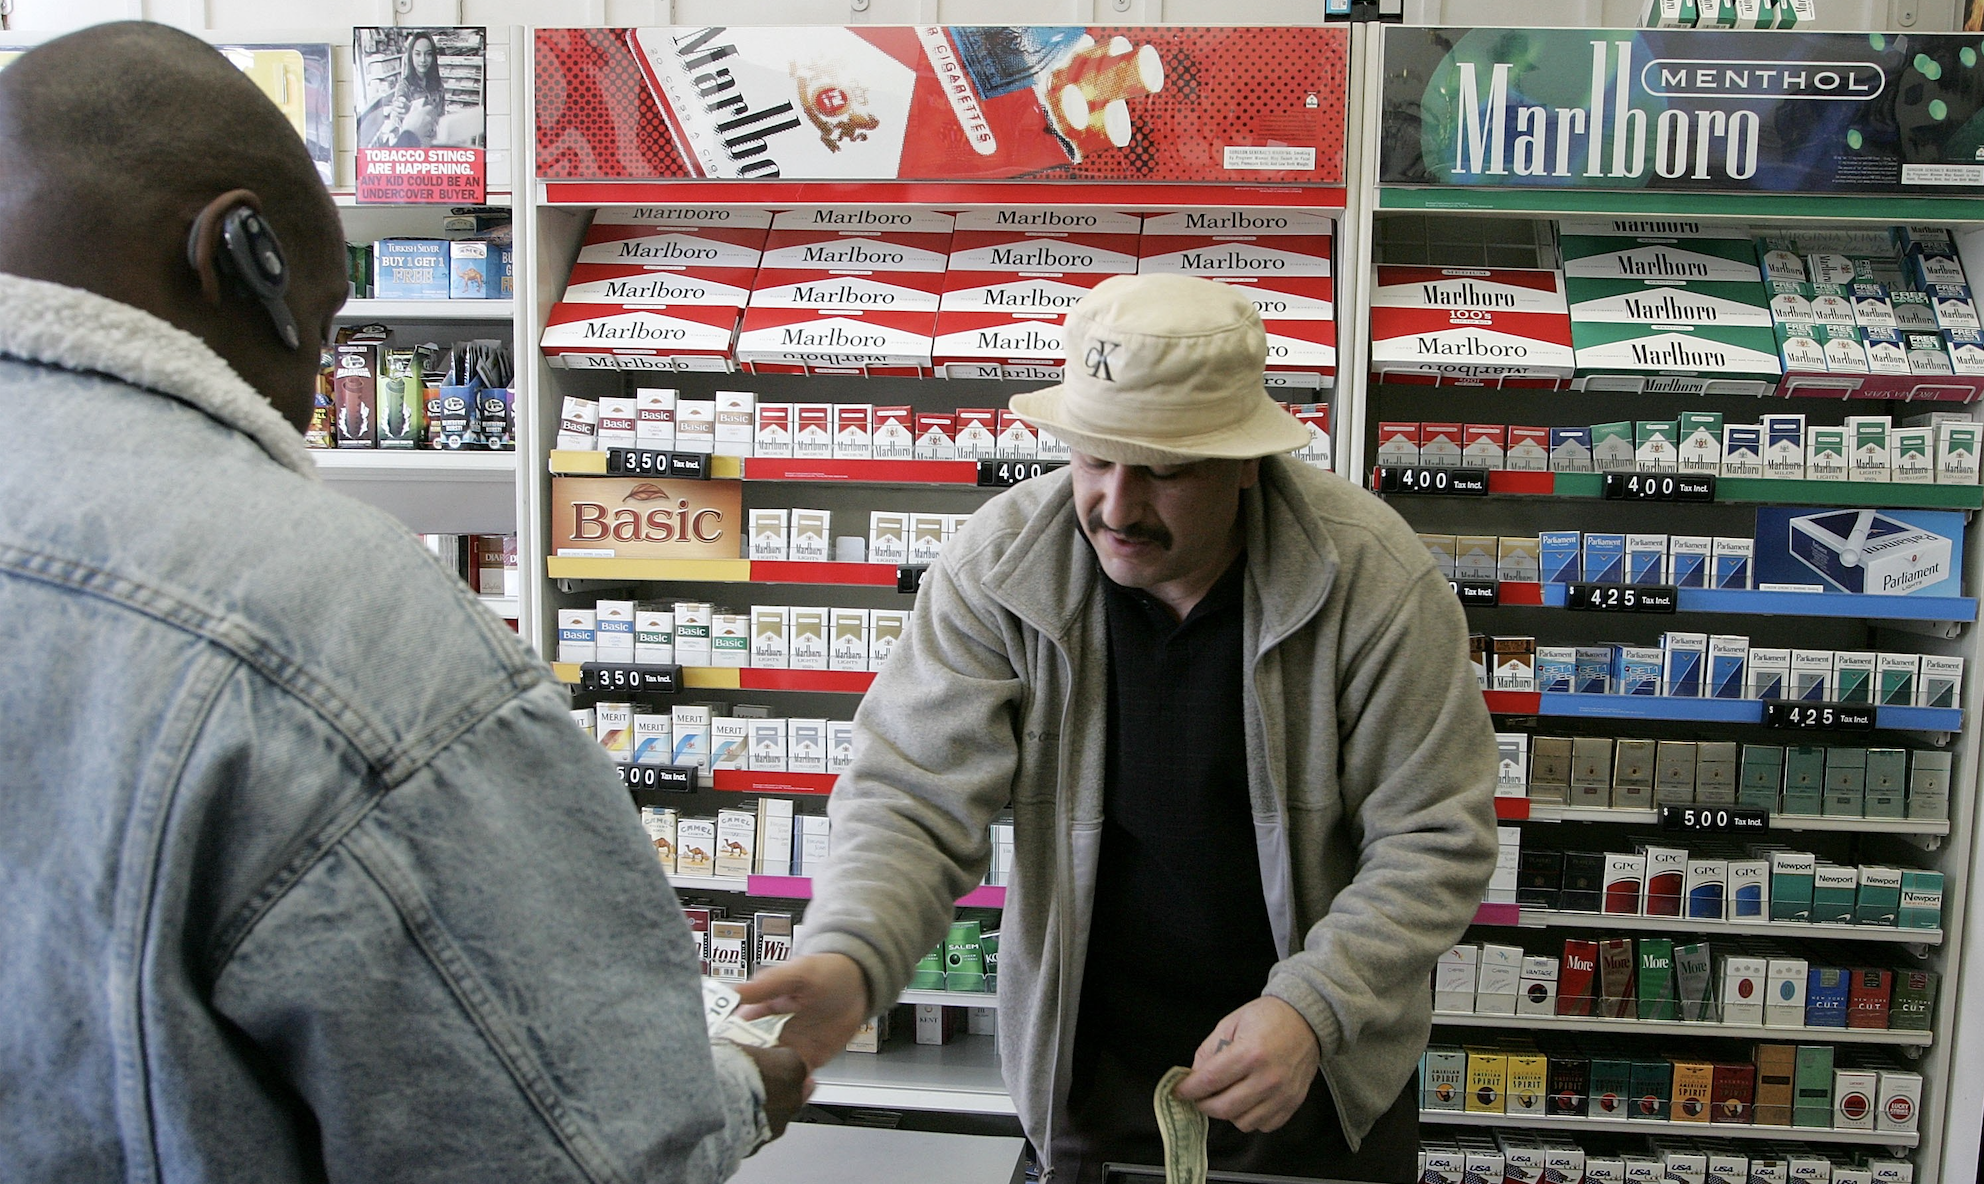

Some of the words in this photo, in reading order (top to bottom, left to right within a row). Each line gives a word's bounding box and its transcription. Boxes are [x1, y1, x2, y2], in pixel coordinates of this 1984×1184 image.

[1660, 69, 1869, 92] MENTHOL
[935, 45, 991, 142] CIGARETTES
[1451, 41, 1760, 181] Marlboro
[365, 150, 425, 162] TOBACCO
[428, 150, 476, 162] STINGS
[367, 163, 392, 174] ARE
[395, 163, 474, 175] HAPPENING.
[361, 176, 382, 187] ANY
[386, 176, 404, 187] KID
[407, 176, 443, 187] COULD
[447, 177, 461, 187] BE
[465, 177, 480, 187] AN
[362, 188, 433, 199] UNDERCOVER
[439, 189, 478, 200] BUYER.
[812, 209, 912, 225] Marlboro
[995, 210, 1097, 227] Marlboro
[1185, 212, 1288, 229] Marlboro
[618, 242, 718, 260] Marlboro
[802, 246, 903, 264] Marlboro
[382, 256, 404, 267] BUY
[415, 257, 436, 267] GET
[990, 248, 1093, 267] Marlboro
[1180, 252, 1285, 270] Marlboro
[1618, 253, 1708, 276] Marlboro
[392, 268, 433, 284] FREE
[604, 281, 705, 299] Marlboro
[791, 286, 895, 305] Marlboro
[1423, 283, 1515, 307] Marlboro
[1624, 296, 1717, 321] Marlboro
[583, 322, 686, 340] Marlboro
[1867, 327, 1895, 335] FREE
[780, 327, 886, 348] Marlboro
[1910, 335, 1937, 345] FREE
[1416, 337, 1527, 358] Marlboro
[1631, 341, 1726, 367] Marlboro
[1787, 350, 1824, 364] Marlboro
[588, 356, 689, 370] Marlboro
[1644, 378, 1703, 392] Marlboro
[641, 410, 670, 421] Basic
[720, 413, 749, 423] Basic
[562, 421, 591, 434] Basic
[603, 418, 632, 429] Basic
[680, 422, 709, 432] Basic
[875, 441, 911, 457] Marlboro
[626, 453, 667, 472] 3.50
[673, 460, 686, 468] Tax
[1684, 454, 1717, 470] Marlboro
[1768, 455, 1801, 470] Marlboro
[999, 464, 1041, 483] 4.00
[1726, 462, 1759, 475] Marlboro
[1403, 469, 1447, 490] 4.00
[1454, 481, 1466, 489] Tax
[1628, 476, 1673, 497] 4.00
[1680, 483, 1692, 492] Tax
[570, 498, 723, 543] Basic
[1543, 535, 1576, 545] Parliament
[1587, 536, 1621, 547] Parliament
[1630, 537, 1663, 547] Parliament
[1675, 541, 1708, 550] Parliament
[1717, 541, 1750, 551] Parliament
[1883, 562, 1940, 590] Parliament
[1902, 580, 1922, 592] LIGHTS
[1591, 588, 1635, 608] 4.25
[1641, 596, 1654, 604] Tax
[601, 622, 629, 632] Basic
[677, 627, 706, 637] Basic
[563, 630, 590, 640] Basic
[640, 633, 668, 643] Basic
[715, 638, 743, 648] Basic
[1713, 643, 1745, 654] Parliament
[1538, 649, 1572, 659] Parliament
[1625, 650, 1659, 660] Parliament
[1753, 653, 1786, 663] Parliament
[1838, 655, 1872, 665] Parliament
[1926, 659, 1960, 670] Parliament
[600, 670, 639, 689] 3.50
[1497, 673, 1532, 688] Marlboro
[601, 712, 627, 722] MERIT
[677, 714, 703, 723] MERIT
[1789, 707, 1833, 727] 4.25
[1840, 715, 1853, 723] Tax
[638, 723, 665, 732] MERIT
[716, 725, 743, 735] MERIT
[644, 817, 675, 828] CAMEL
[721, 817, 751, 827] CAMEL
[1684, 810, 1728, 829] 5.00
[1734, 817, 1746, 826] Tax
[680, 825, 712, 836] CAMEL
[1655, 854, 1682, 863] GPC
[1612, 862, 1640, 871] GPC
[1694, 866, 1722, 876] GPC
[1777, 861, 1812, 871] Newport
[1735, 868, 1762, 877] GPC
[1819, 874, 1853, 884] Newport
[1866, 875, 1899, 886] Newport
[1904, 892, 1940, 902] Newport
[948, 943, 979, 951] SALEM
[1567, 955, 1594, 972] More
[1642, 954, 1669, 969] More
[1526, 968, 1554, 977] VANTAGE
[708, 996, 730, 1016] 10
[1816, 1001, 1839, 1009] CUT
[1858, 1003, 1881, 1011] CUT
[1902, 1004, 1925, 1012] CUT
[919, 1016, 939, 1024] KENT
[1431, 1076, 1459, 1084] SPIRIT
[1473, 1077, 1500, 1086] SPIRIT
[1513, 1080, 1541, 1088] SPIRIT
[1554, 1082, 1582, 1090] SPIRIT
[1679, 1089, 1707, 1097] SPIRIT
[1429, 1159, 1450, 1167] USA
[1878, 1170, 1898, 1178] USA
